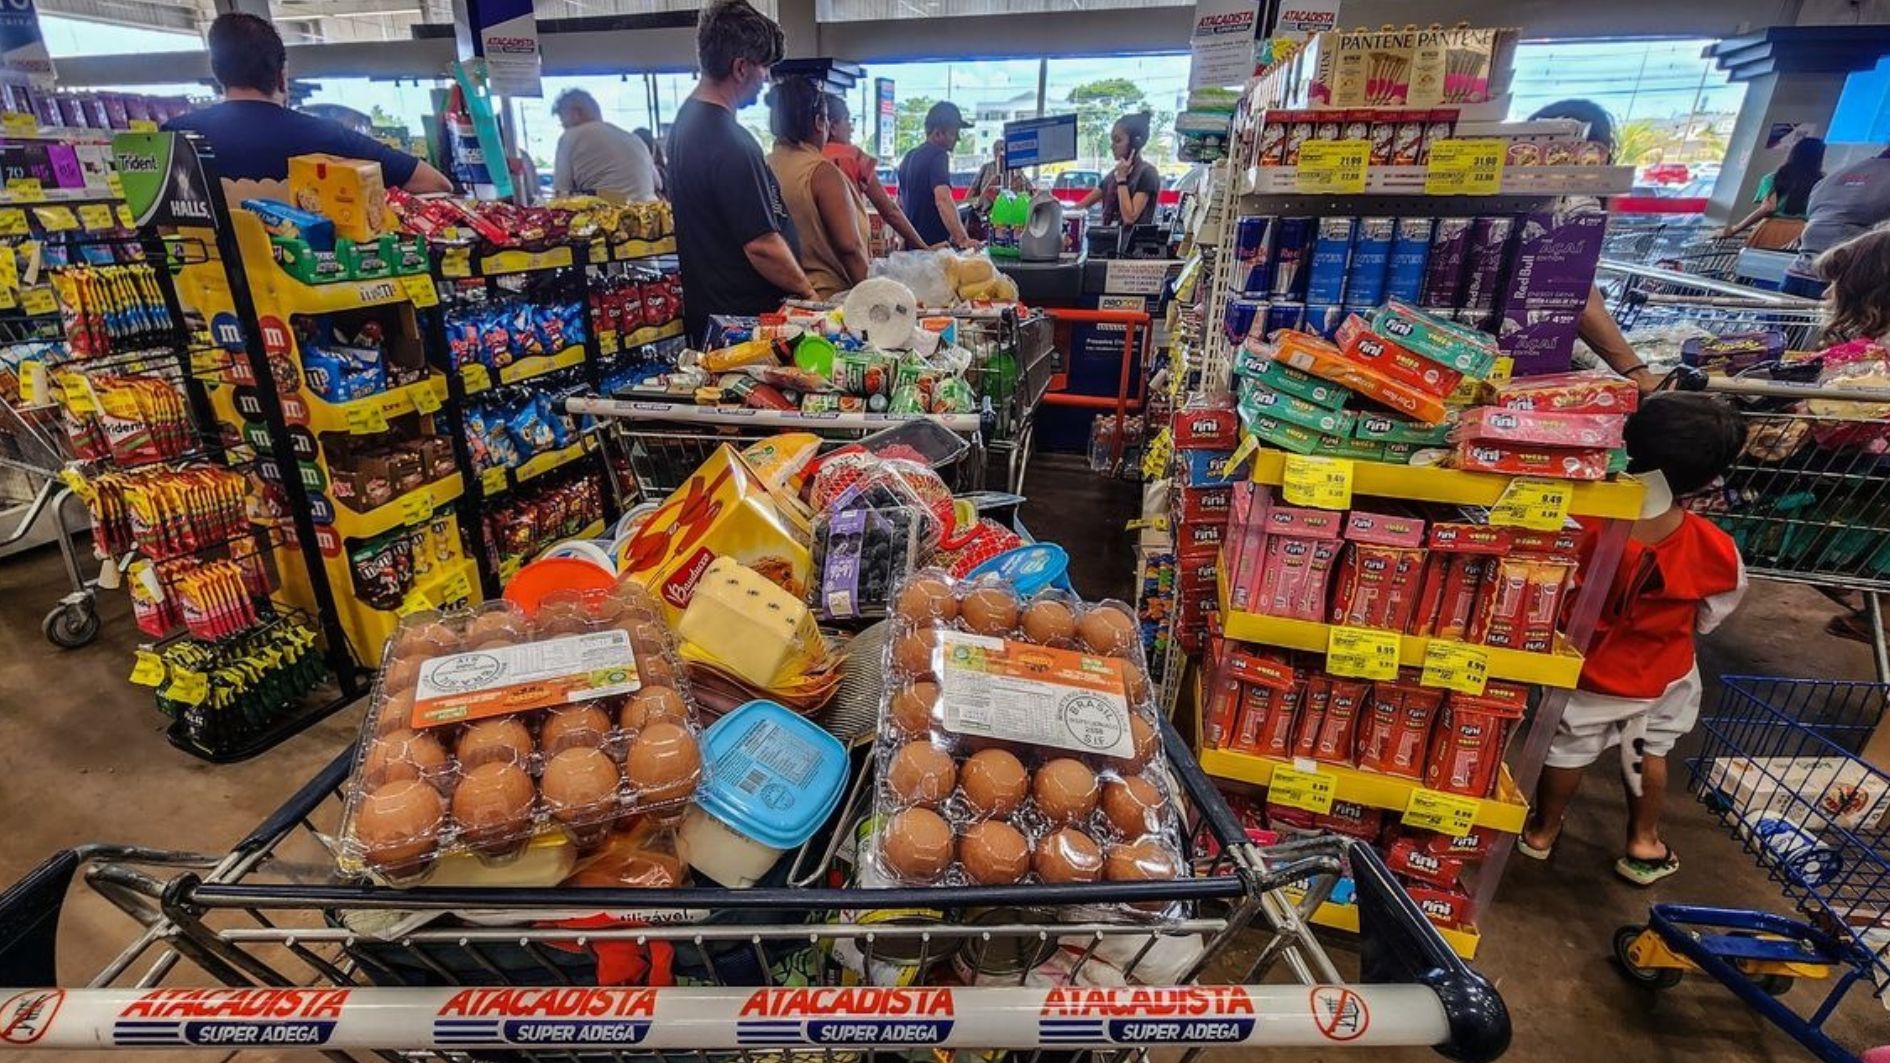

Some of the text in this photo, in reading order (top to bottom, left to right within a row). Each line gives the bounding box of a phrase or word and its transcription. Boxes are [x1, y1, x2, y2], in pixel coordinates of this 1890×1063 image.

[1341, 33, 1414, 50] PANTENE
[1418, 30, 1491, 47] PANTENE
[117, 154, 158, 172] Trident
[170, 201, 209, 217] HALLS
[1070, 700, 1113, 721] BRASIL
[119, 988, 351, 1018] ATACADISTA
[437, 988, 658, 1017] ATACADISTA
[739, 988, 955, 1017] ATACADISTA
[1040, 986, 1256, 1016] ATACADISTA
[199, 1025, 320, 1042] SUPER ADEGA
[517, 1024, 636, 1041] SUPER ADEGA
[820, 1024, 938, 1041] SUPER ADEGA
[1122, 1023, 1241, 1040] SUPER ADEGA
